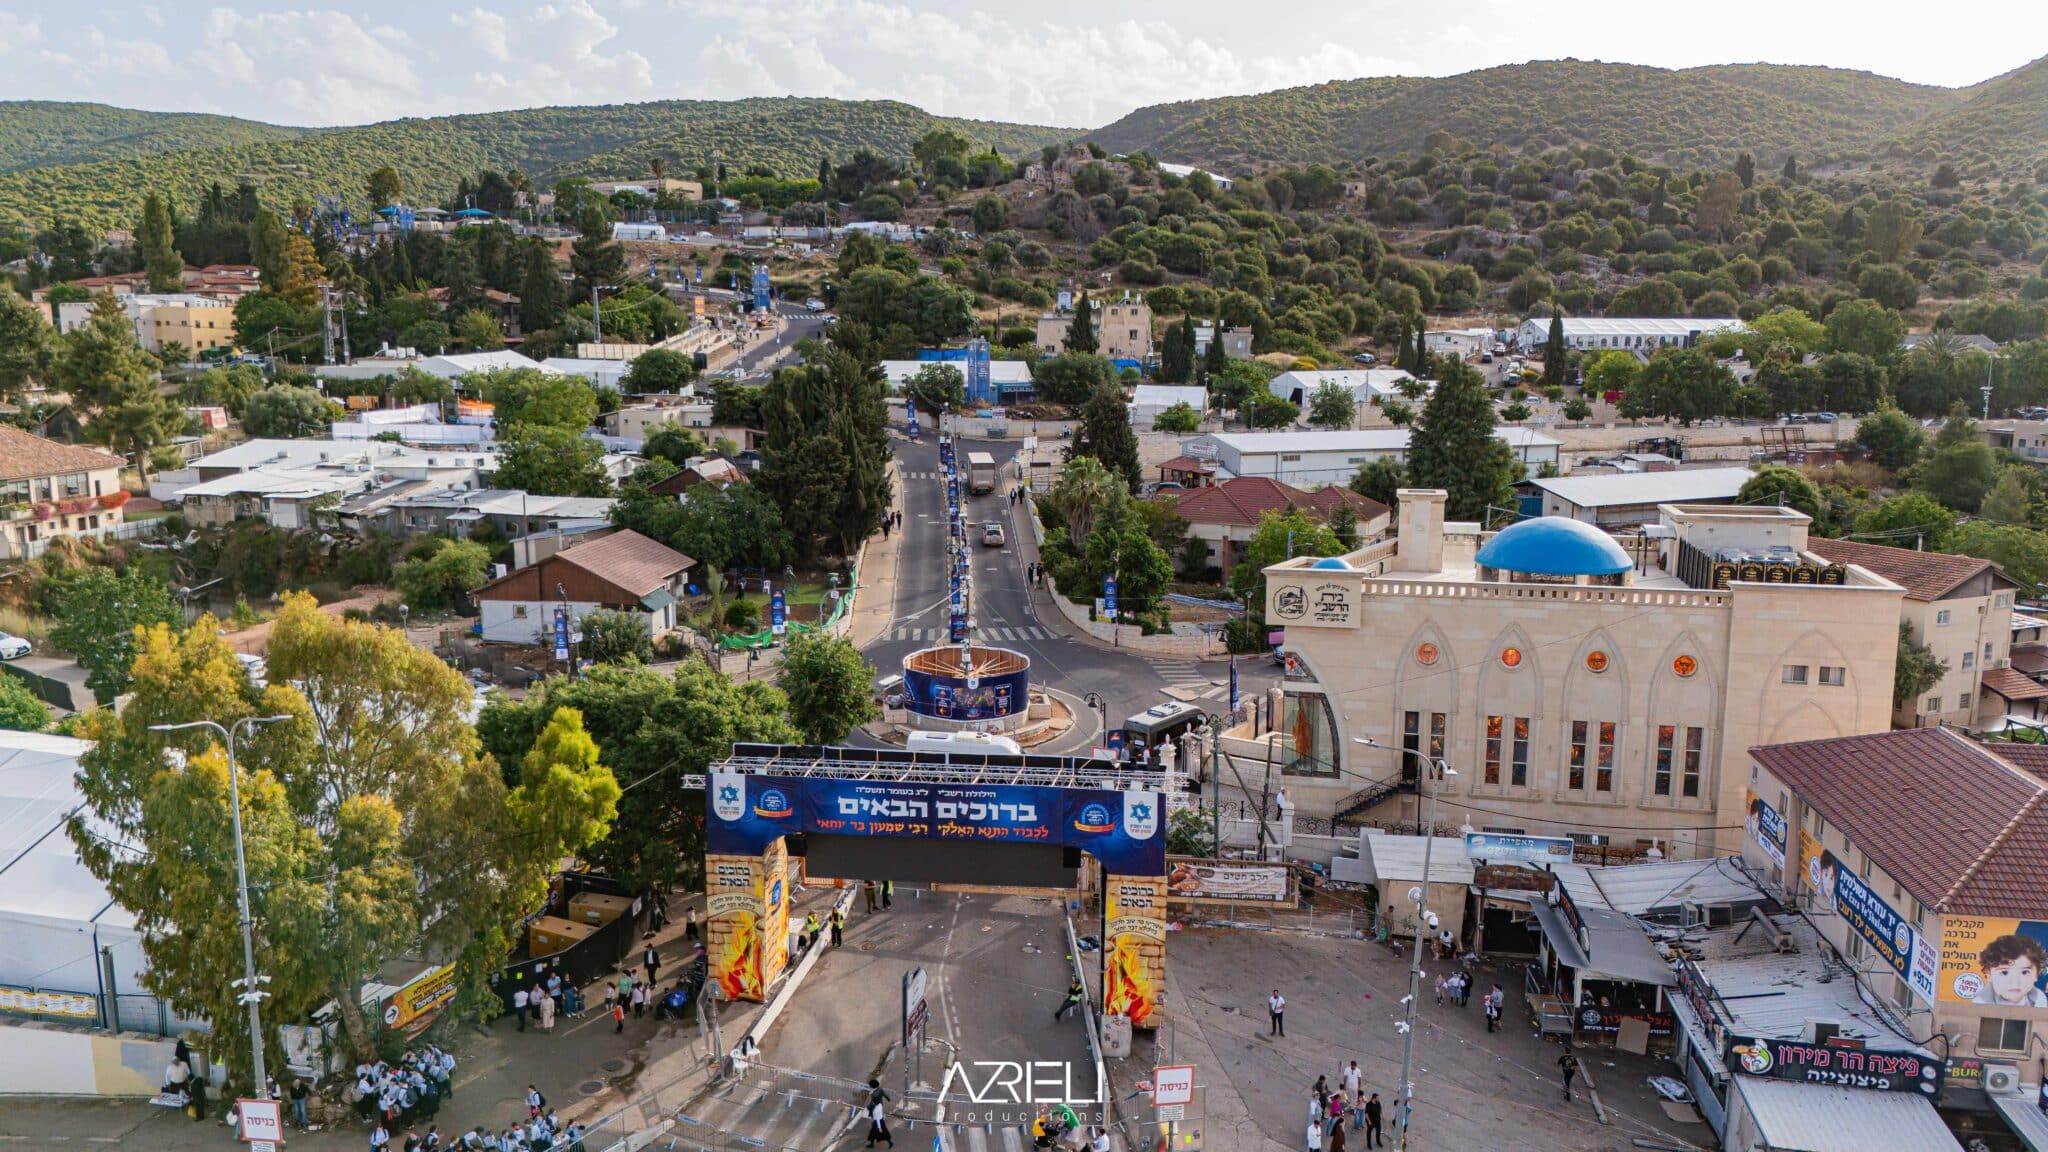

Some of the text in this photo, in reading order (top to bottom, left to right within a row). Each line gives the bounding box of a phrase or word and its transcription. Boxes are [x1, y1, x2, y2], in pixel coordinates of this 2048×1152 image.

[1321, 592, 1344, 602] בית
[887, 788, 914, 796] בעומר
[965, 790, 997, 798] הילולת
[837, 795, 1038, 822] ברוכים הבאים
[718, 865, 750, 876] ברוכים
[720, 877, 750, 887] הבאים
[1840, 869, 1868, 902] ושולמית
[1121, 886, 1154, 896] ברוכים
[1121, 898, 1153, 908] הבאים
[1867, 893, 1887, 920] עזרא
[1946, 918, 1985, 929] מקבלים
[1944, 930, 1977, 939] בברכה
[1943, 940, 1960, 948] את
[1942, 950, 1977, 960] העולים
[1894, 955, 1905, 971] לא
[1941, 961, 1971, 970] למירון
[1778, 1045, 1831, 1067] מירון
[1836, 1051, 1864, 1070] הר
[1869, 1055, 1920, 1077] פיצה
[1807, 1069, 1890, 1090] פיצוצייה
[1161, 1081, 1189, 1092] כניסה
[247, 1116, 275, 1127] כניסה
